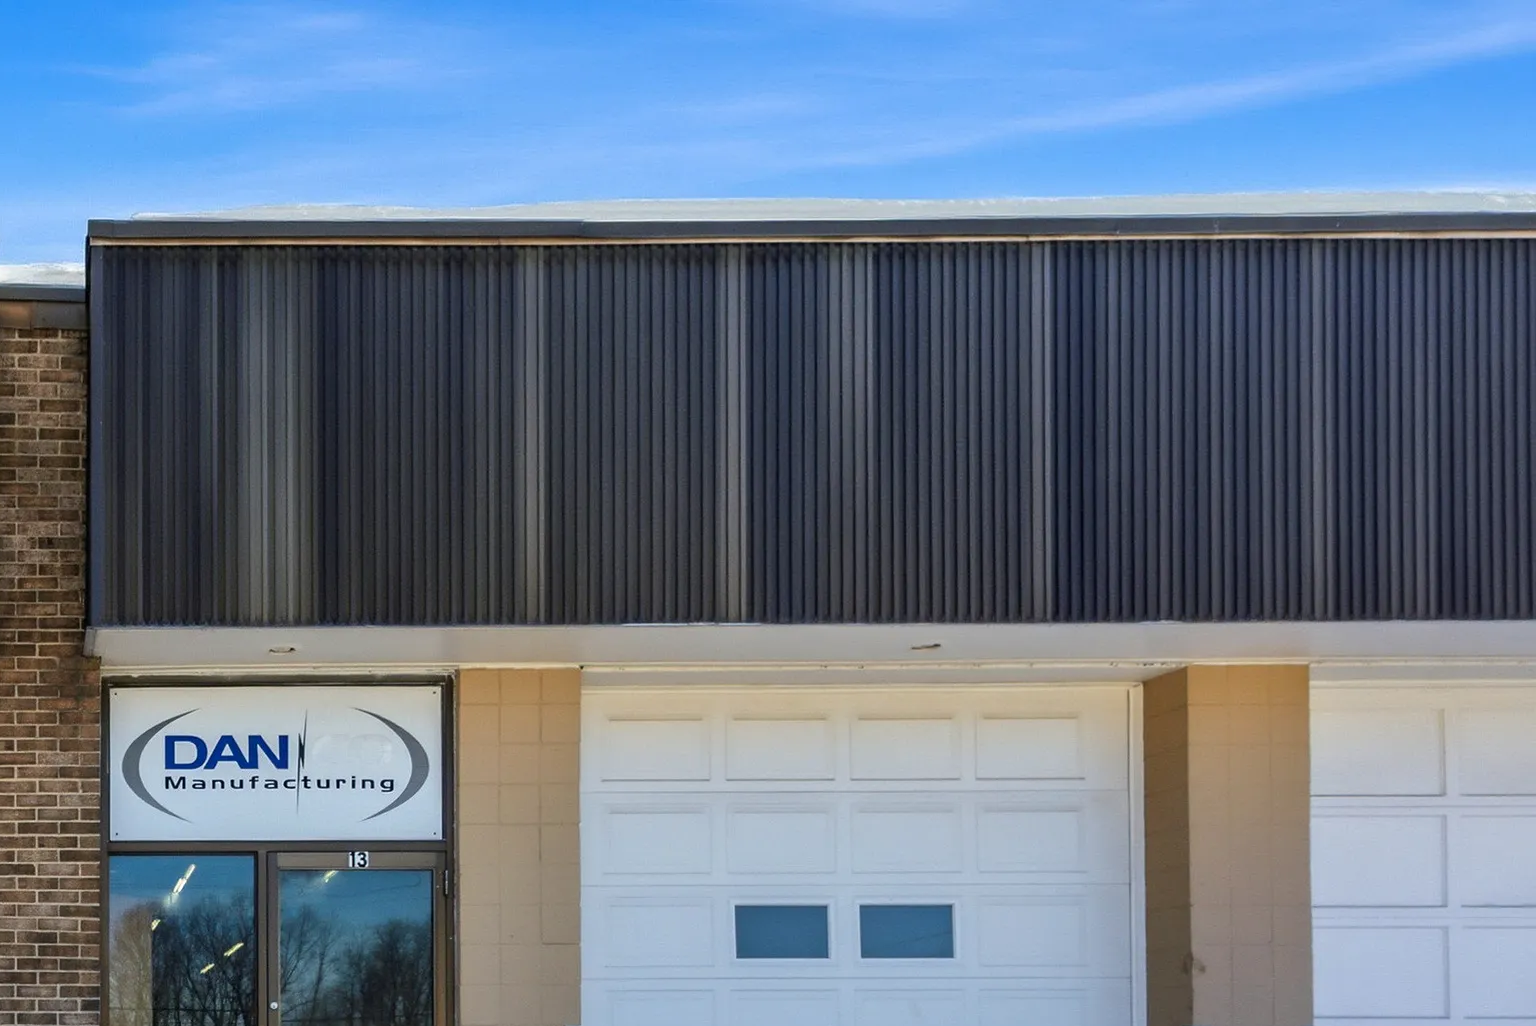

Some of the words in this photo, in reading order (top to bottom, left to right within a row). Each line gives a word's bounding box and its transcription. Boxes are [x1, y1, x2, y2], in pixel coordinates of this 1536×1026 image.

[165, 735, 289, 770] DAN
[165, 775, 395, 793] Manufacturing
[350, 852, 368, 868] 13
